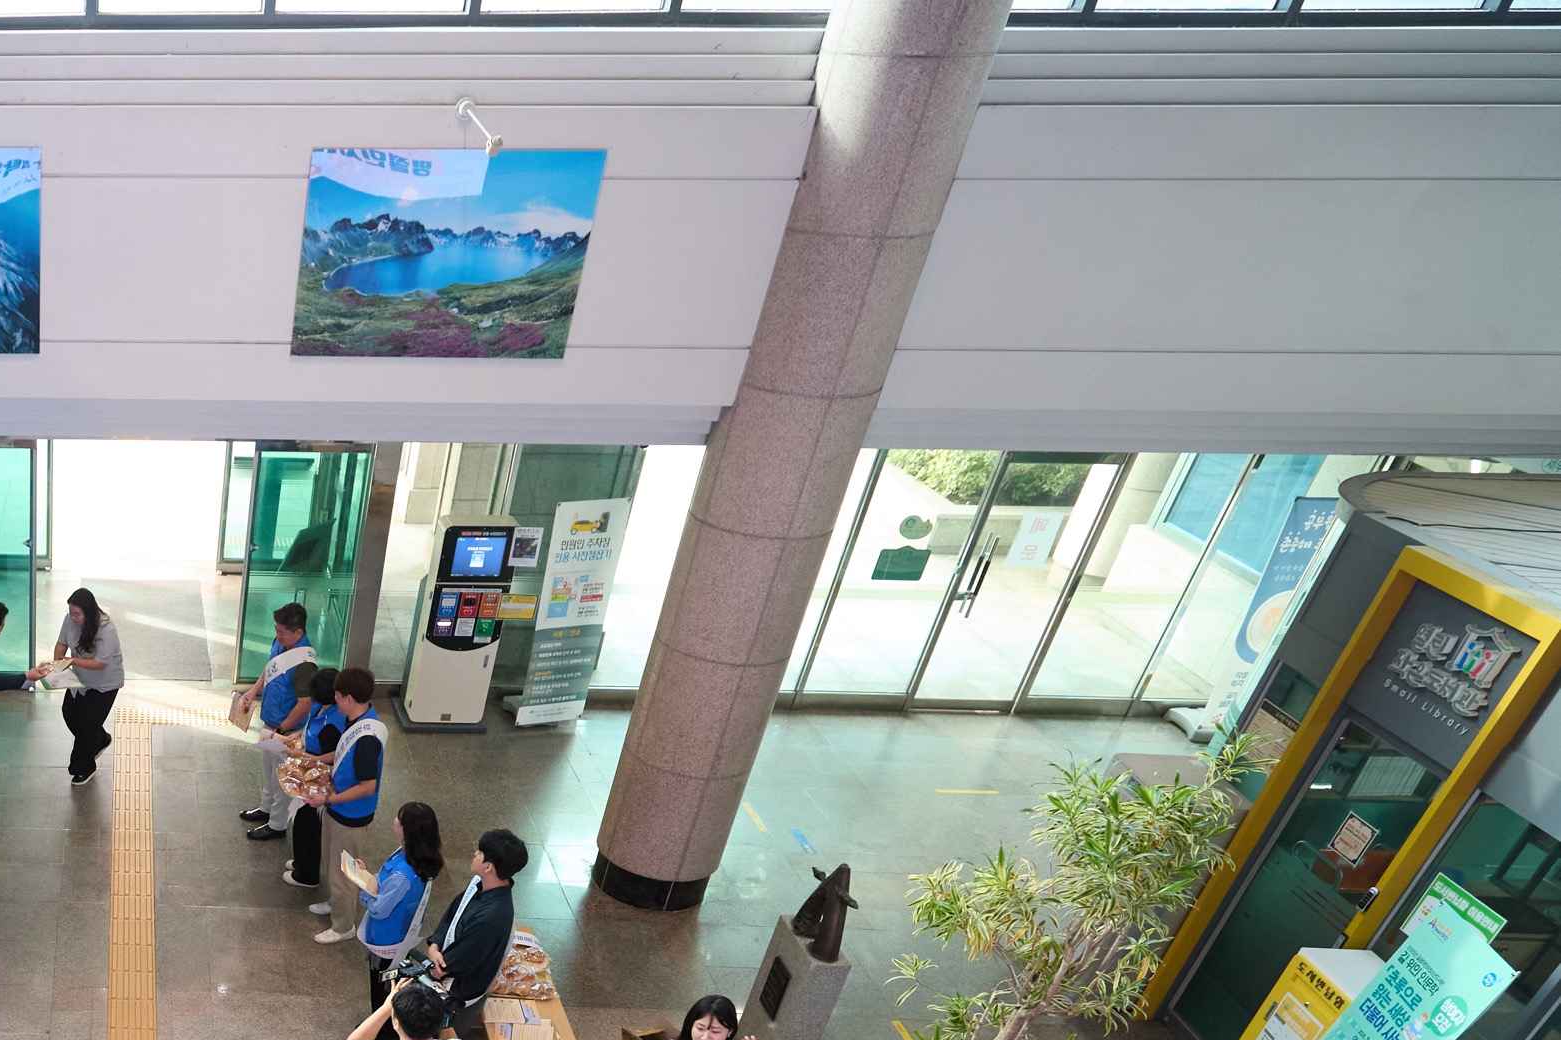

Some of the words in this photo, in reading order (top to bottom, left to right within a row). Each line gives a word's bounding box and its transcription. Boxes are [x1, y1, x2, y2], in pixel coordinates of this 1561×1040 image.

[1384, 678, 1417, 704] Small
[1421, 702, 1470, 735] Library
[1293, 961, 1349, 1010] 도서반납함
[1370, 982, 1396, 1009] 읽는
[1396, 950, 1411, 965] 길
[1415, 971, 1441, 997] 인문학
[1357, 998, 1390, 1032] 더불어
